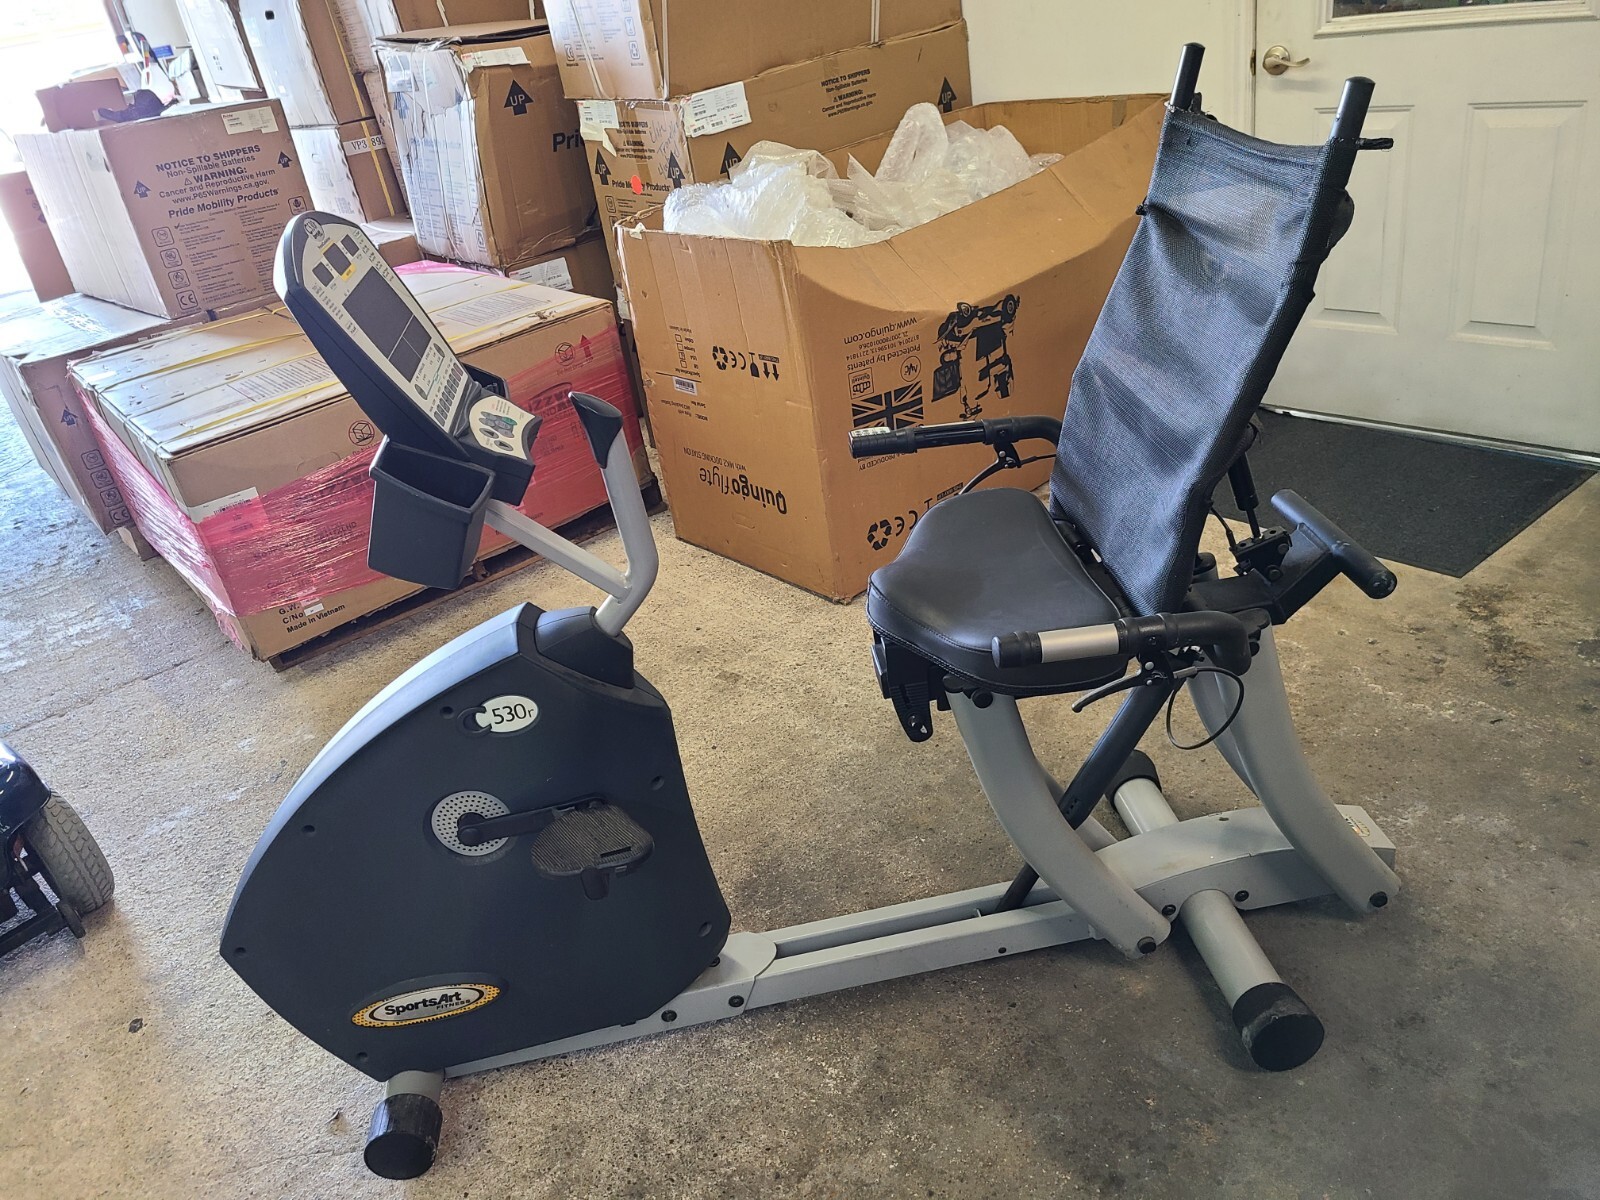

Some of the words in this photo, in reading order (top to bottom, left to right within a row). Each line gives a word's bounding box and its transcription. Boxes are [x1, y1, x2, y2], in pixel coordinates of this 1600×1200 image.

[510, 94, 525, 106] UP
[942, 91, 952, 104] UP
[553, 129, 584, 153] Pri
[156, 157, 195, 173] NOTICE
[198, 153, 211, 164] TO
[213, 144, 261, 161] SHIPPERS
[166, 162, 220, 178] Non-Spillable
[221, 154, 256, 170] Batteries
[280, 156, 289, 165] UP
[193, 166, 247, 184] WARNING:
[597, 164, 607, 175] UP
[670, 168, 680, 178] UP
[136, 186, 146, 194] UP
[159, 186, 187, 199] Cancer
[188, 182, 204, 192] and
[205, 174, 255, 190] Reproductive
[256, 168, 276, 178] Harm
[612, 180, 626, 189] Pride
[646, 183, 669, 192] Products
[168, 205, 195, 219] Pride
[197, 198, 235, 213] Mobility
[237, 188, 278, 204] Products
[844, 317, 917, 345] www.quingo.com
[876, 355, 886, 363] by
[887, 344, 921, 362] Protected
[847, 356, 875, 371] patents
[683, 447, 702, 459] STATION
[702, 452, 723, 466] DOCKING
[724, 459, 735, 469] MK2
[735, 463, 747, 472] with
[700, 465, 730, 495] flyte
[732, 474, 787, 515] Quingo
[286, 621, 308, 634] Made
[308, 615, 316, 624] in
[316, 603, 346, 621] Vietnam
[491, 703, 534, 726] 530r
[385, 991, 462, 1016] SportsArt
[436, 999, 471, 1010] FITNESS
